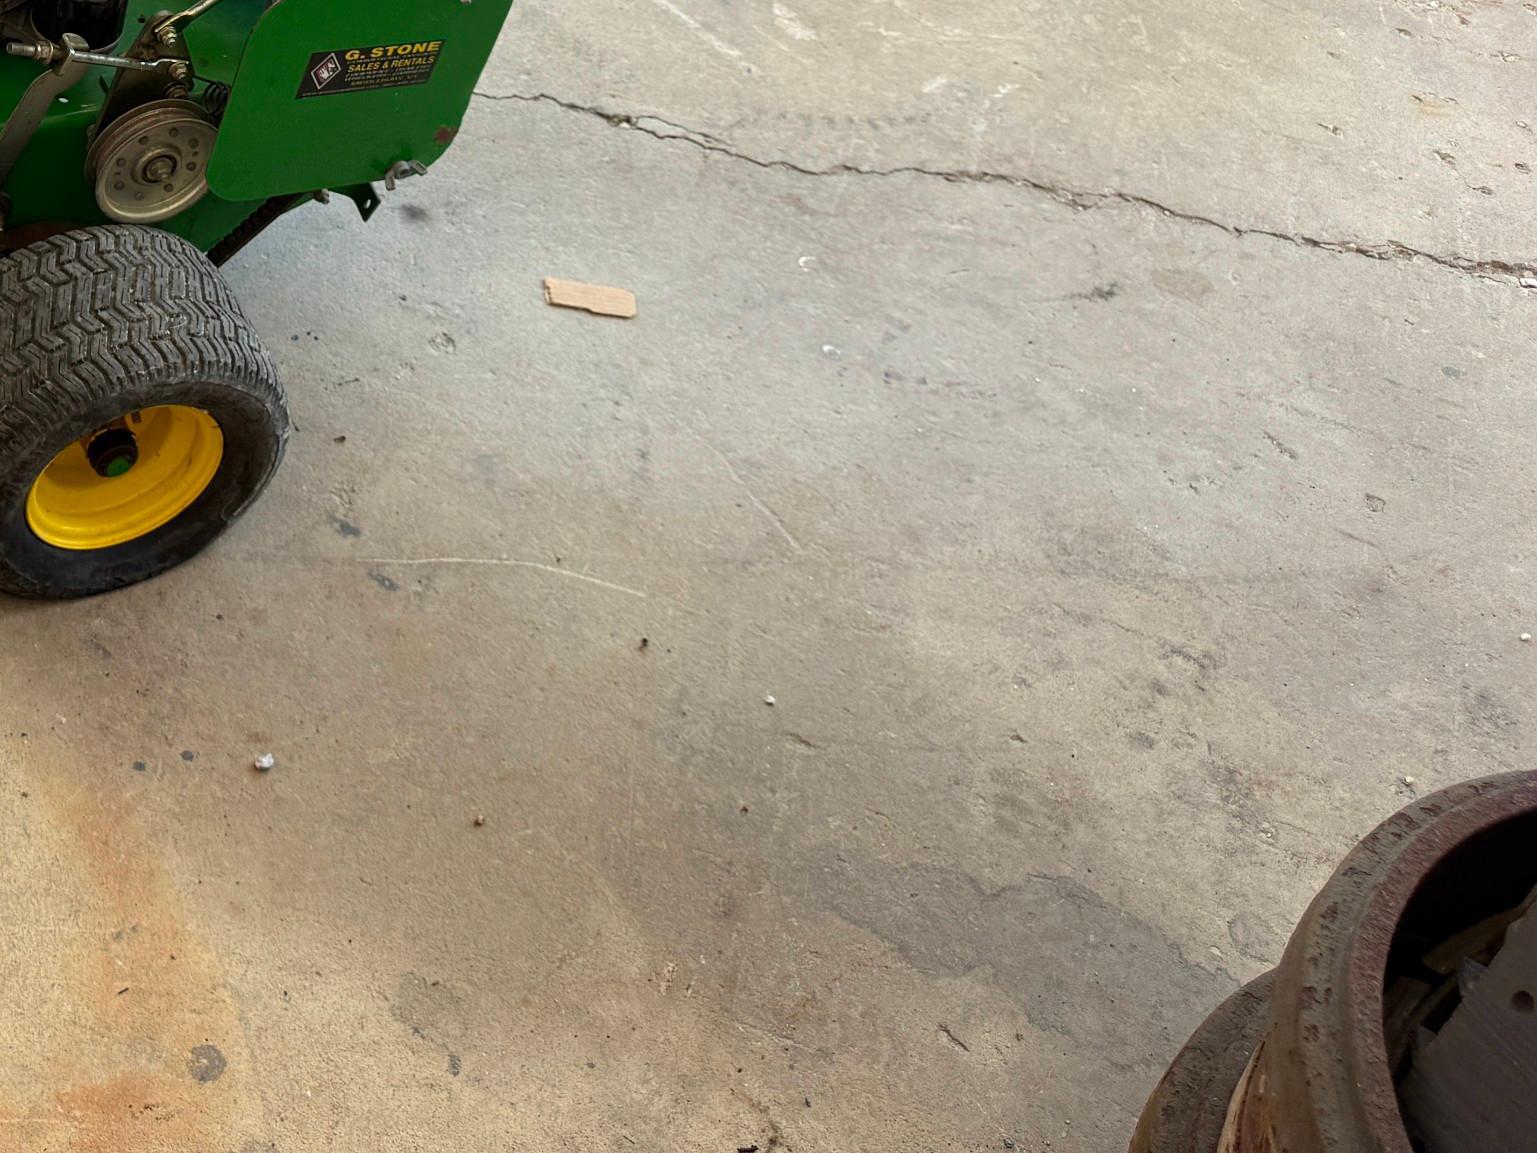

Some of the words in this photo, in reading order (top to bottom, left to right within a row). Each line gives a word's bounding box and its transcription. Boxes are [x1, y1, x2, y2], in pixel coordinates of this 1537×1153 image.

[370, 40, 442, 58] STONE
[347, 59, 380, 73] SALES
[390, 55, 436, 68] RENTALS
